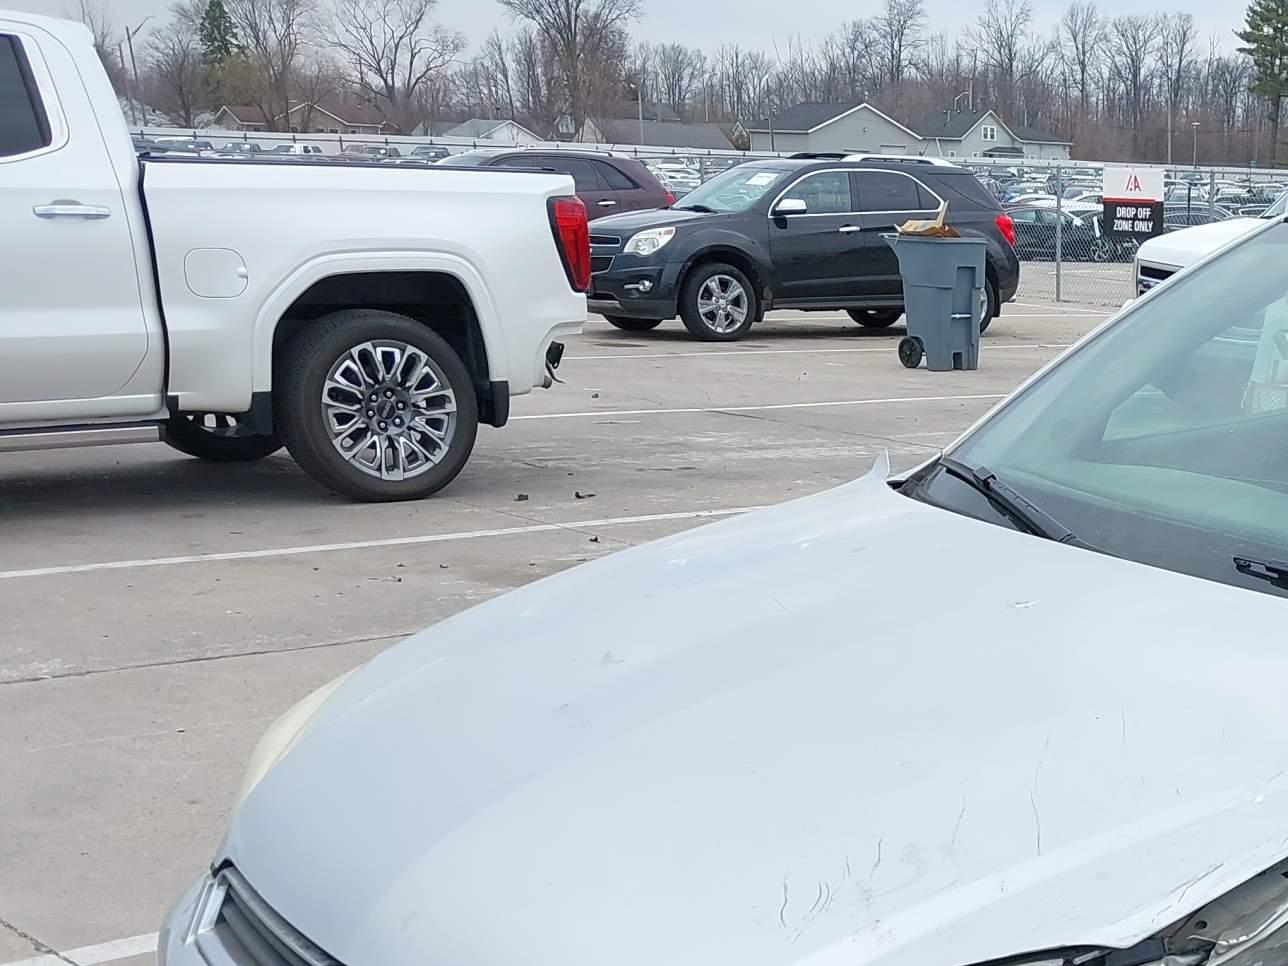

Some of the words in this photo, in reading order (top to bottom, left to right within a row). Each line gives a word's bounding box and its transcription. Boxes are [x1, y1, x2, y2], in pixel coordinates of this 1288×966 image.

[1116, 206, 1136, 218] DROP
[1137, 207, 1151, 219] OFF
[1113, 219, 1133, 232] ZONE
[1134, 220, 1153, 232] ONLY
